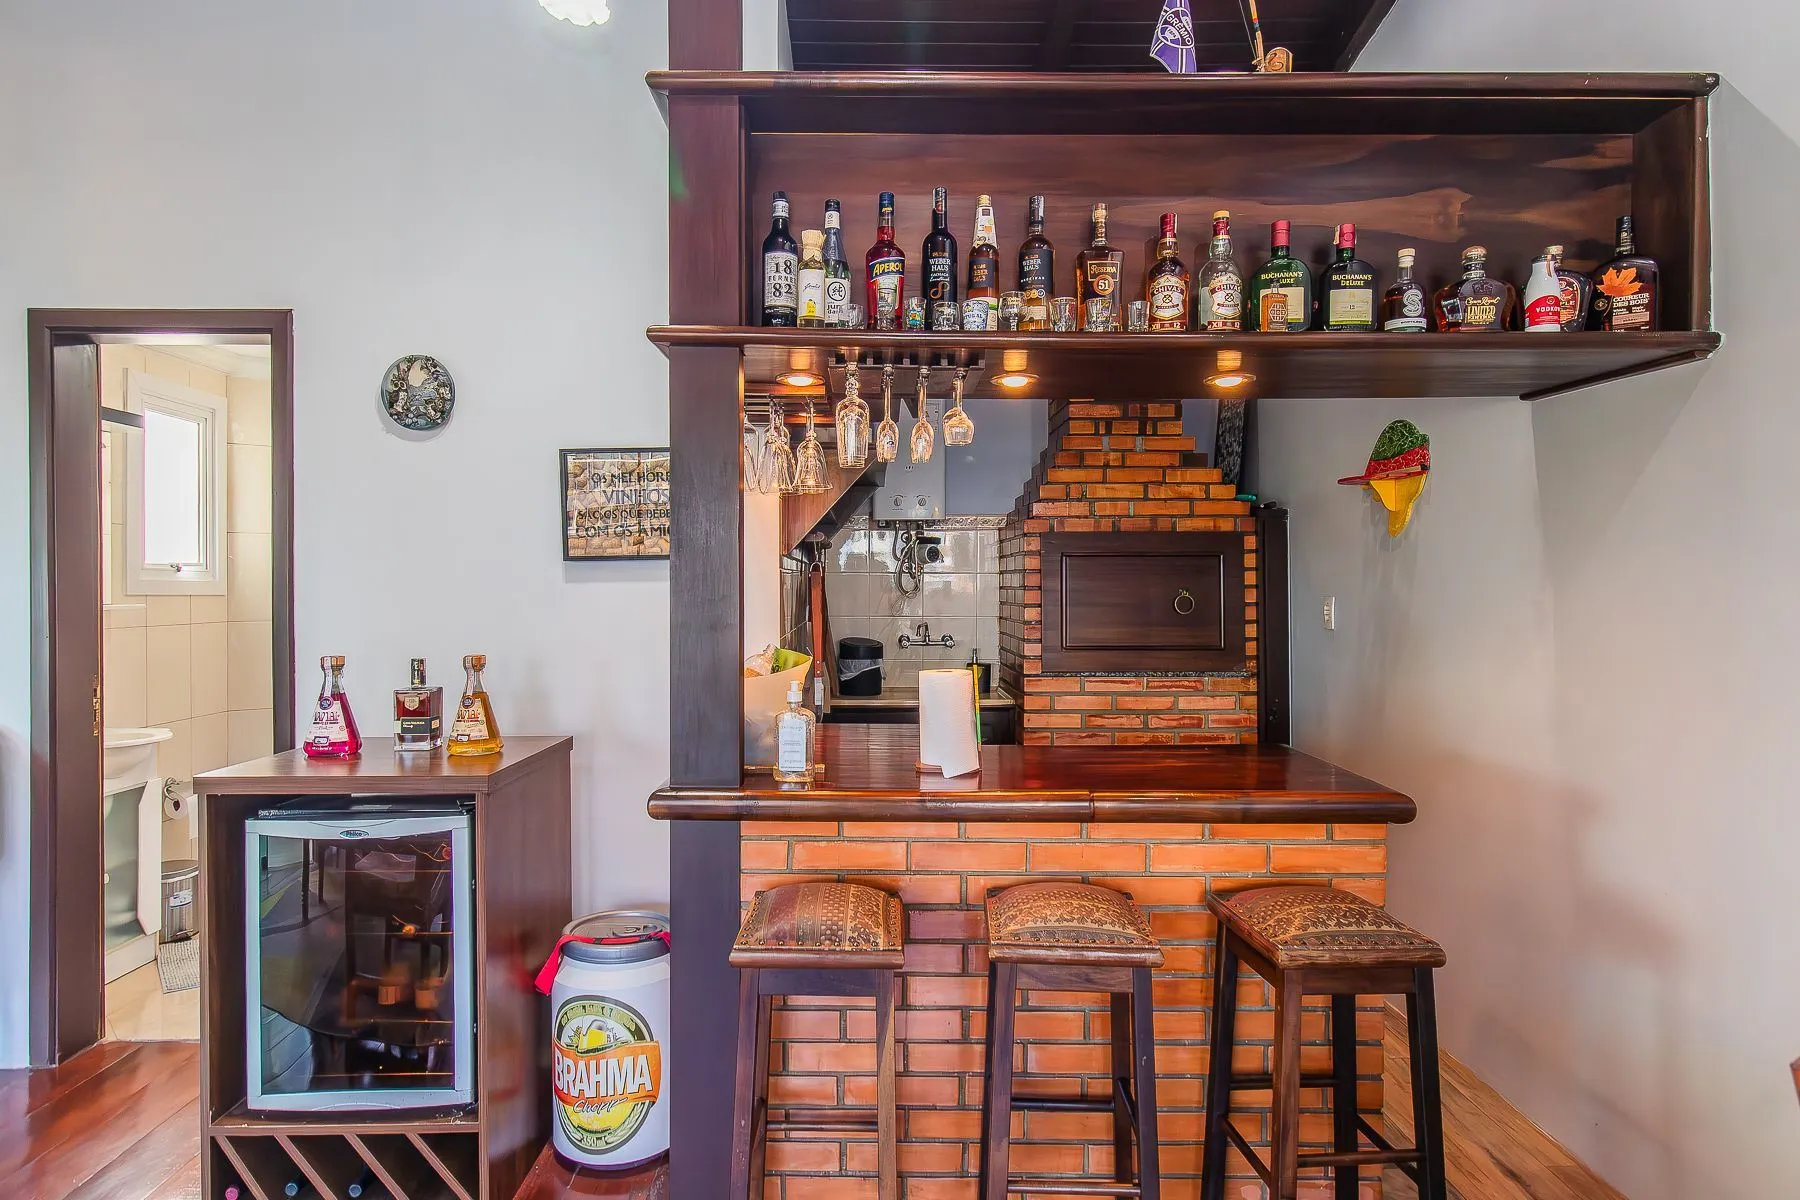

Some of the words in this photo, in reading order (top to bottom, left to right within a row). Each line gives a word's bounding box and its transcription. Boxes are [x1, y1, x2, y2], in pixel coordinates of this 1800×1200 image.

[774, 259, 792, 274] 18
[873, 262, 902, 277] APEROL
[1090, 264, 1117, 273] RESERVA
[1261, 271, 1303, 280] BUCHANAN'S
[772, 282, 793, 298] 82
[1098, 279, 1109, 290] 51
[1154, 285, 1181, 295] CHIVAS
[591, 472, 607, 483] OS
[620, 508, 643, 519] QUE
[554, 1049, 653, 1098] BRAHMA
[573, 1099, 629, 1114] Chopp
